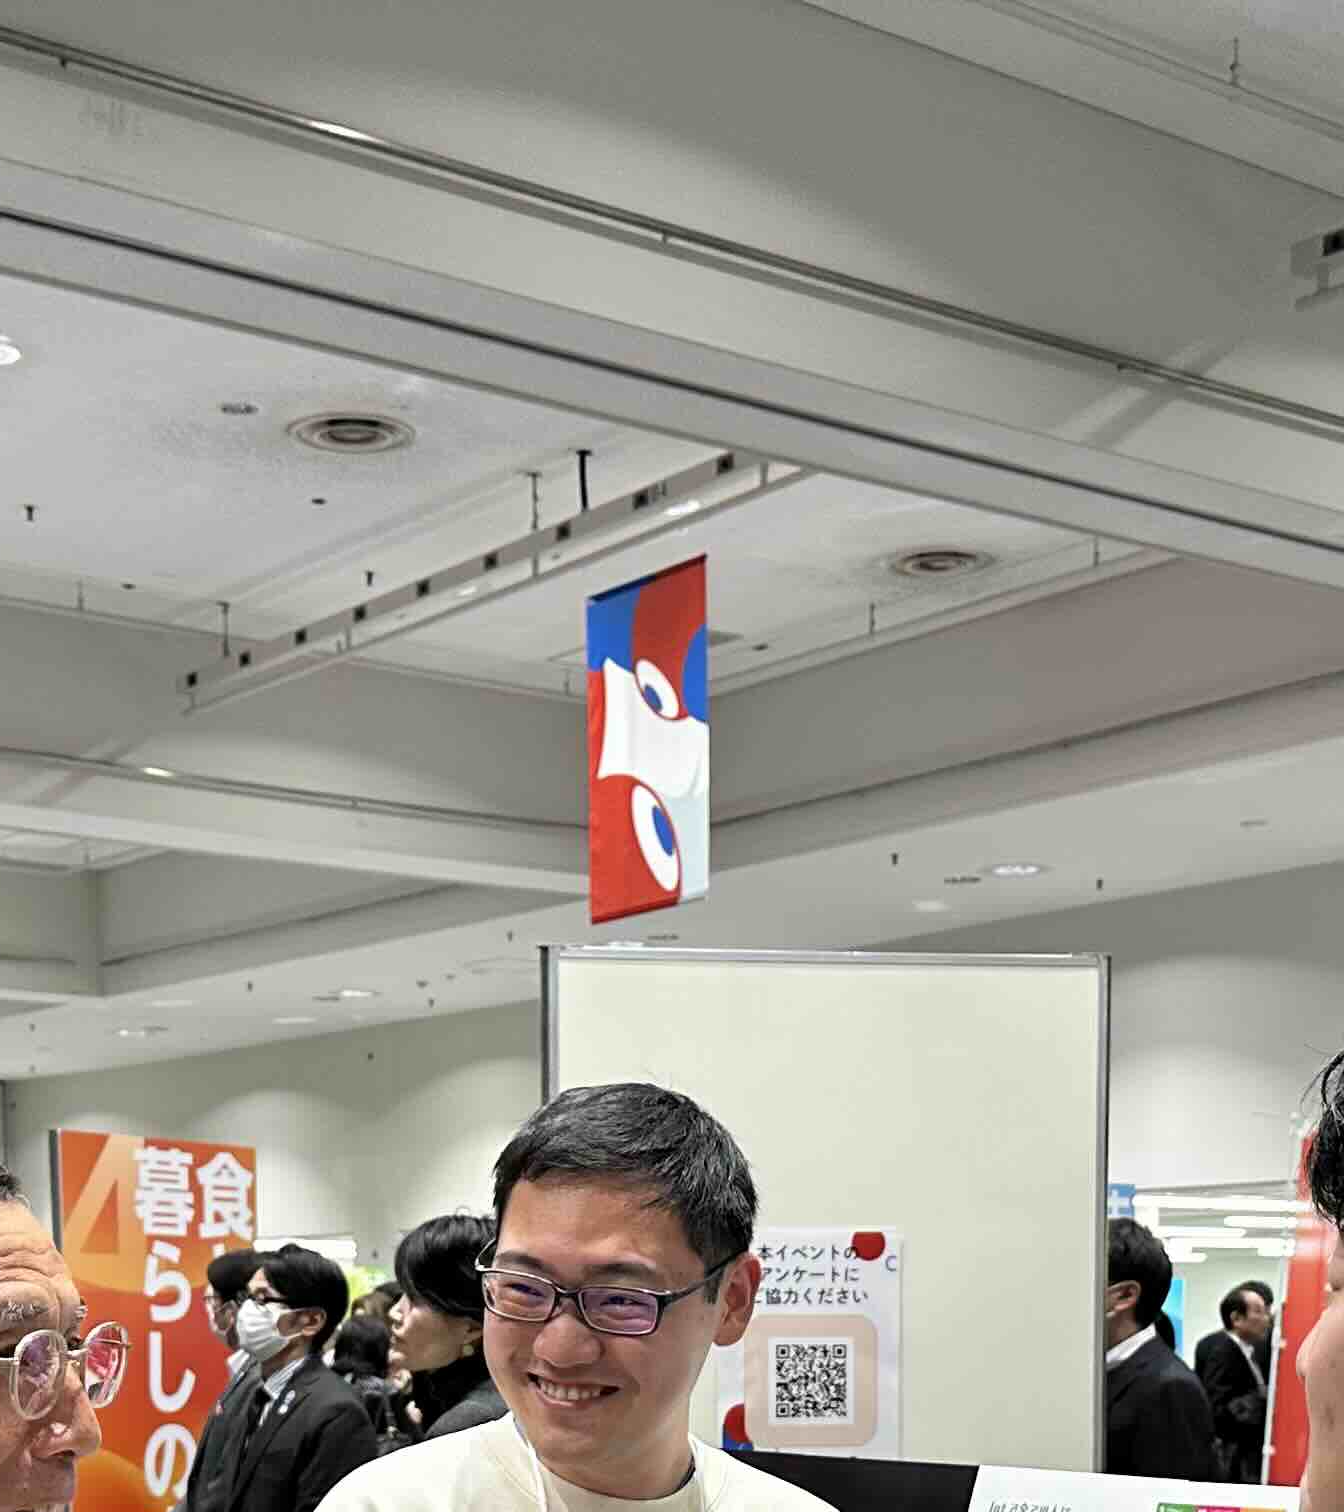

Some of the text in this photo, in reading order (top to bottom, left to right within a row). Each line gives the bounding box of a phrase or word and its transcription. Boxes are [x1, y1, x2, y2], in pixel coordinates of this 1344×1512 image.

[758, 1244, 860, 1261] 本イベントの
